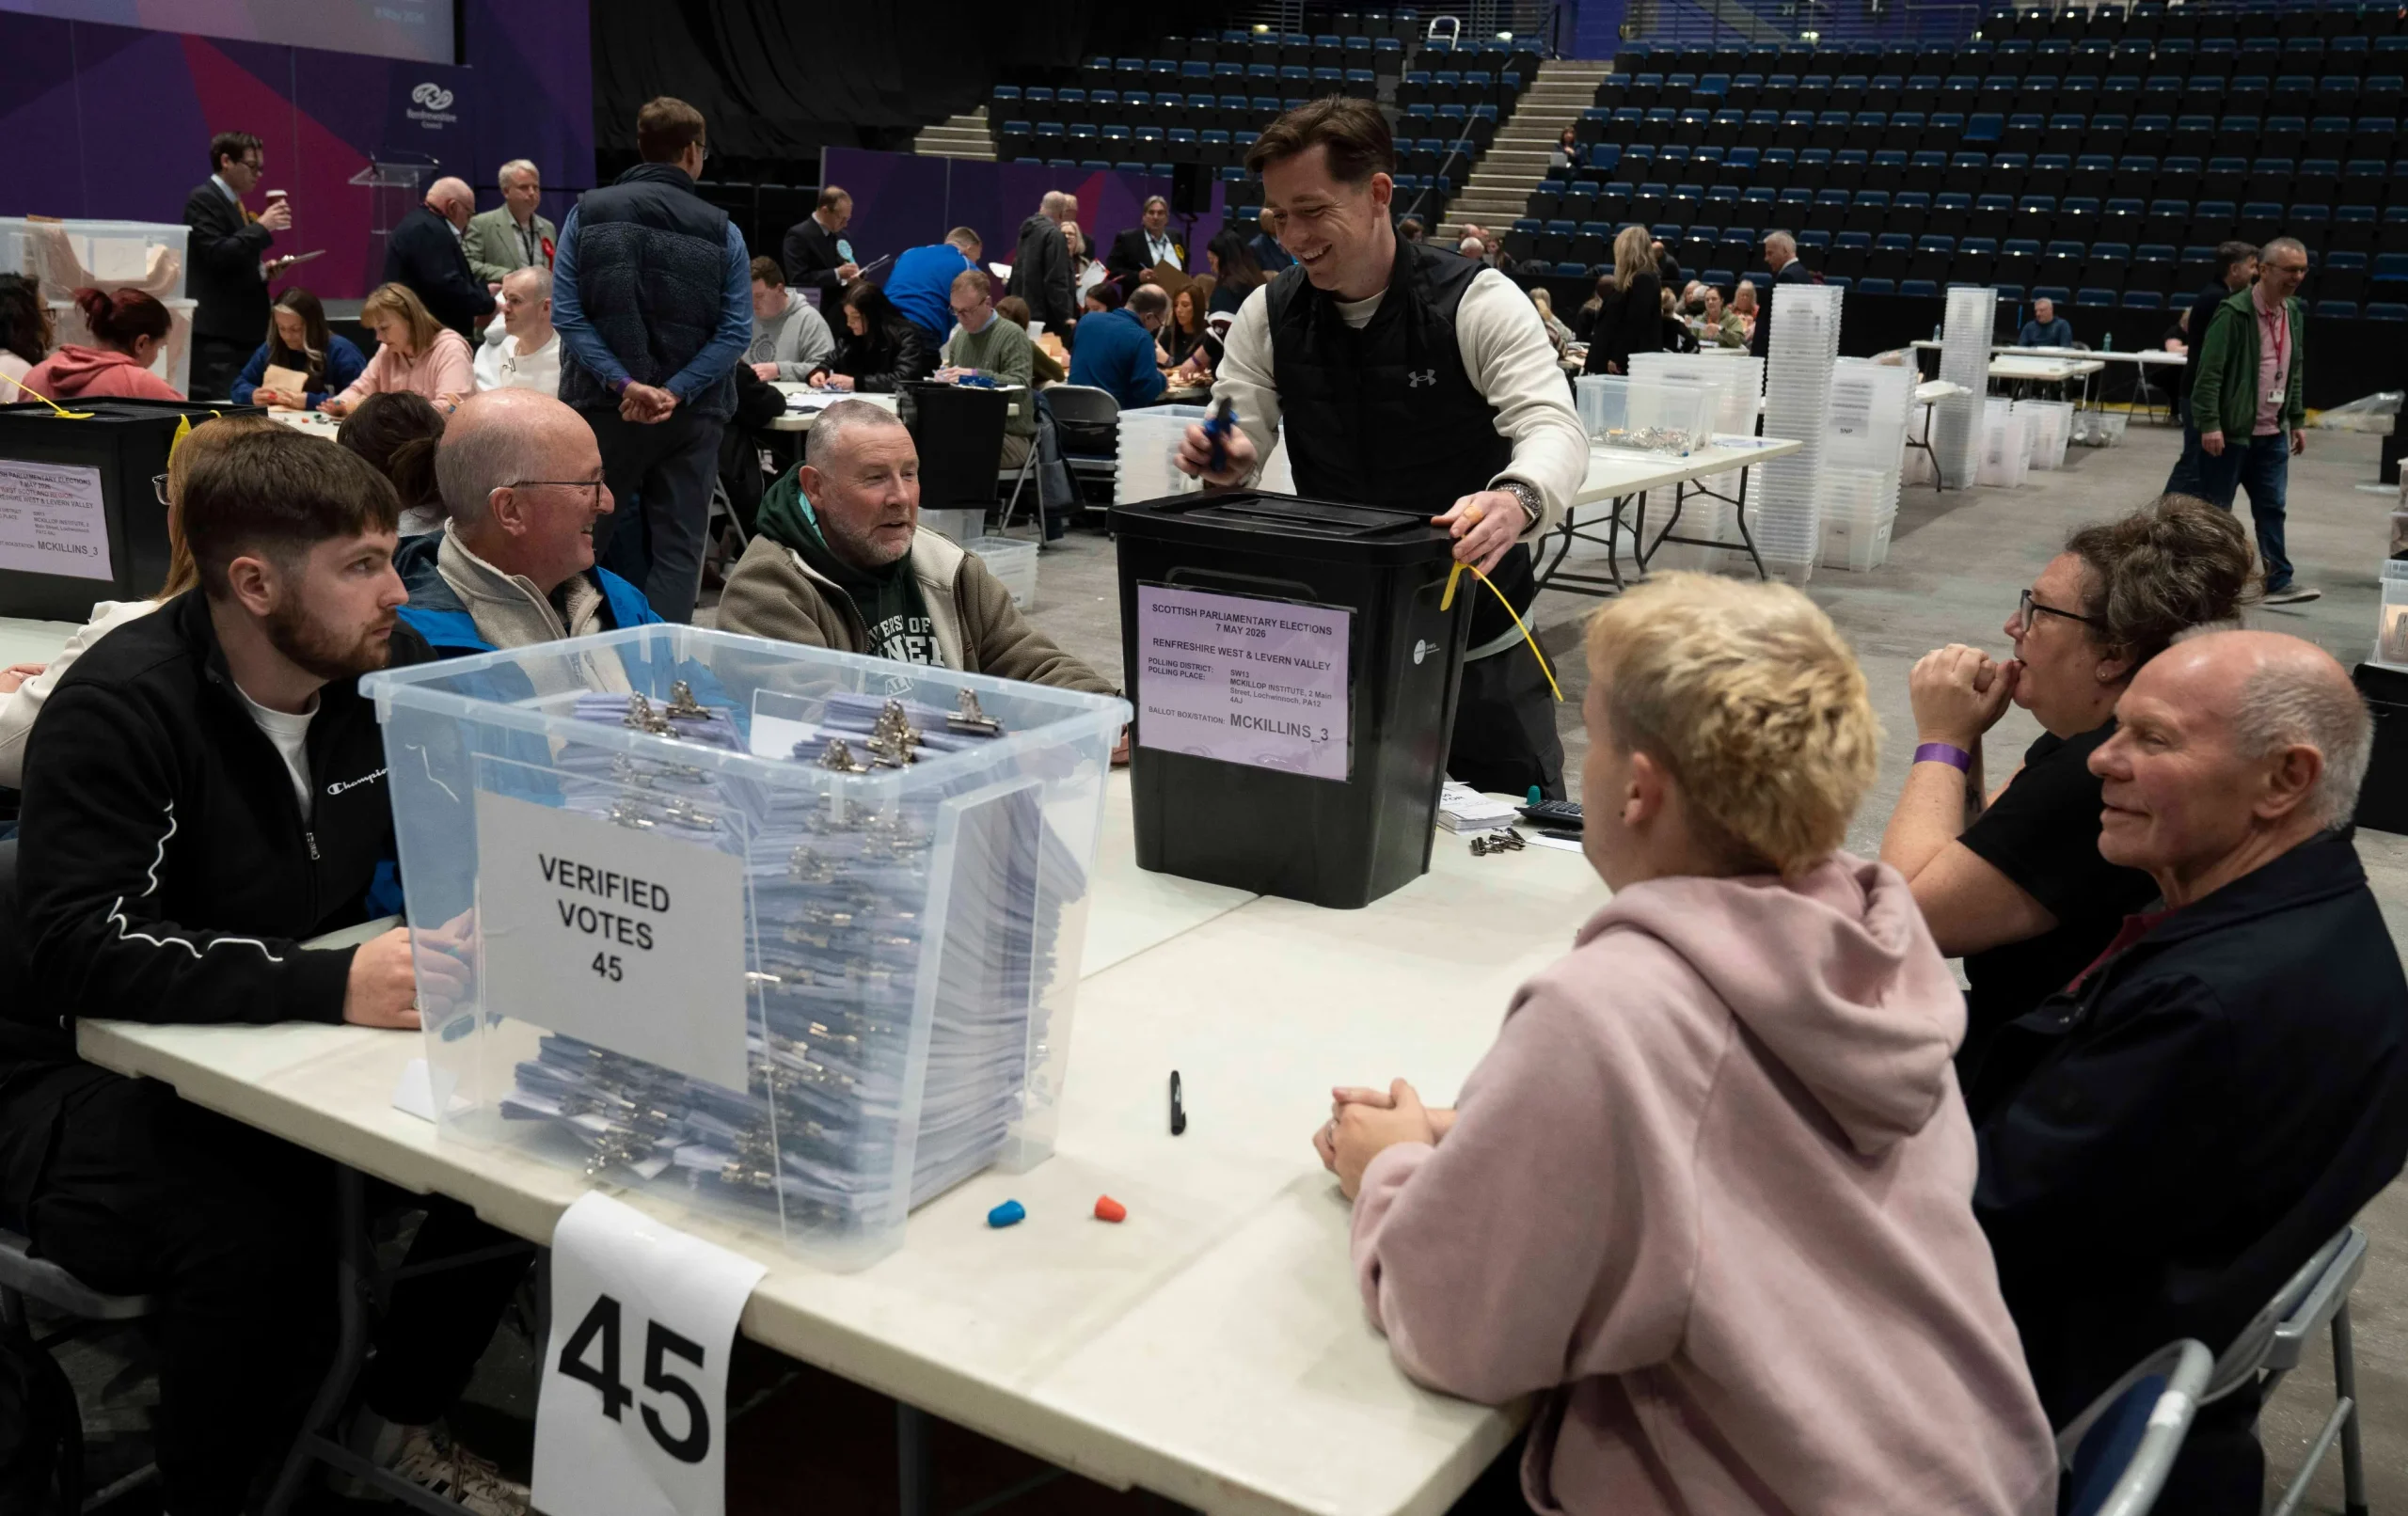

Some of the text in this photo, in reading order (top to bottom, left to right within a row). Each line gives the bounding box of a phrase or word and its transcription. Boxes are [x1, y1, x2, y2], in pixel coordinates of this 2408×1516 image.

[58, 477, 91, 485] ELECTIONS
[38, 541, 98, 557] MCKILLINS_3
[909, 617, 930, 633] OF
[1152, 604, 1332, 636] SCOTTISH PARLIAMENTARY ELECTIONS
[1216, 624, 1266, 638] 7 MAY 2026
[1149, 657, 1213, 672] POLLING DISTRICT:
[1153, 638, 1331, 671] RENFRESHIRE WEST & LEVERN VALLEY
[1149, 666, 1206, 680] POLLING PLACE:
[1230, 670, 1249, 678] SW13
[1230, 678, 1266, 688] MCKILLOP
[1268, 685, 1307, 697] INSTITUTE,
[1315, 691, 1332, 700] Main
[1230, 687, 1321, 707] Street, Lochwinnoch, PA12
[1230, 696, 1243, 704] 4AJ
[1149, 706, 1329, 743] BALLOT BOX/STATION: MCKILLINS_3
[327, 767, 388, 795] Champio
[539, 853, 671, 914] VERIFIED
[557, 898, 654, 951] VOTES
[591, 951, 624, 983] 45
[557, 1293, 710, 1464] 45
